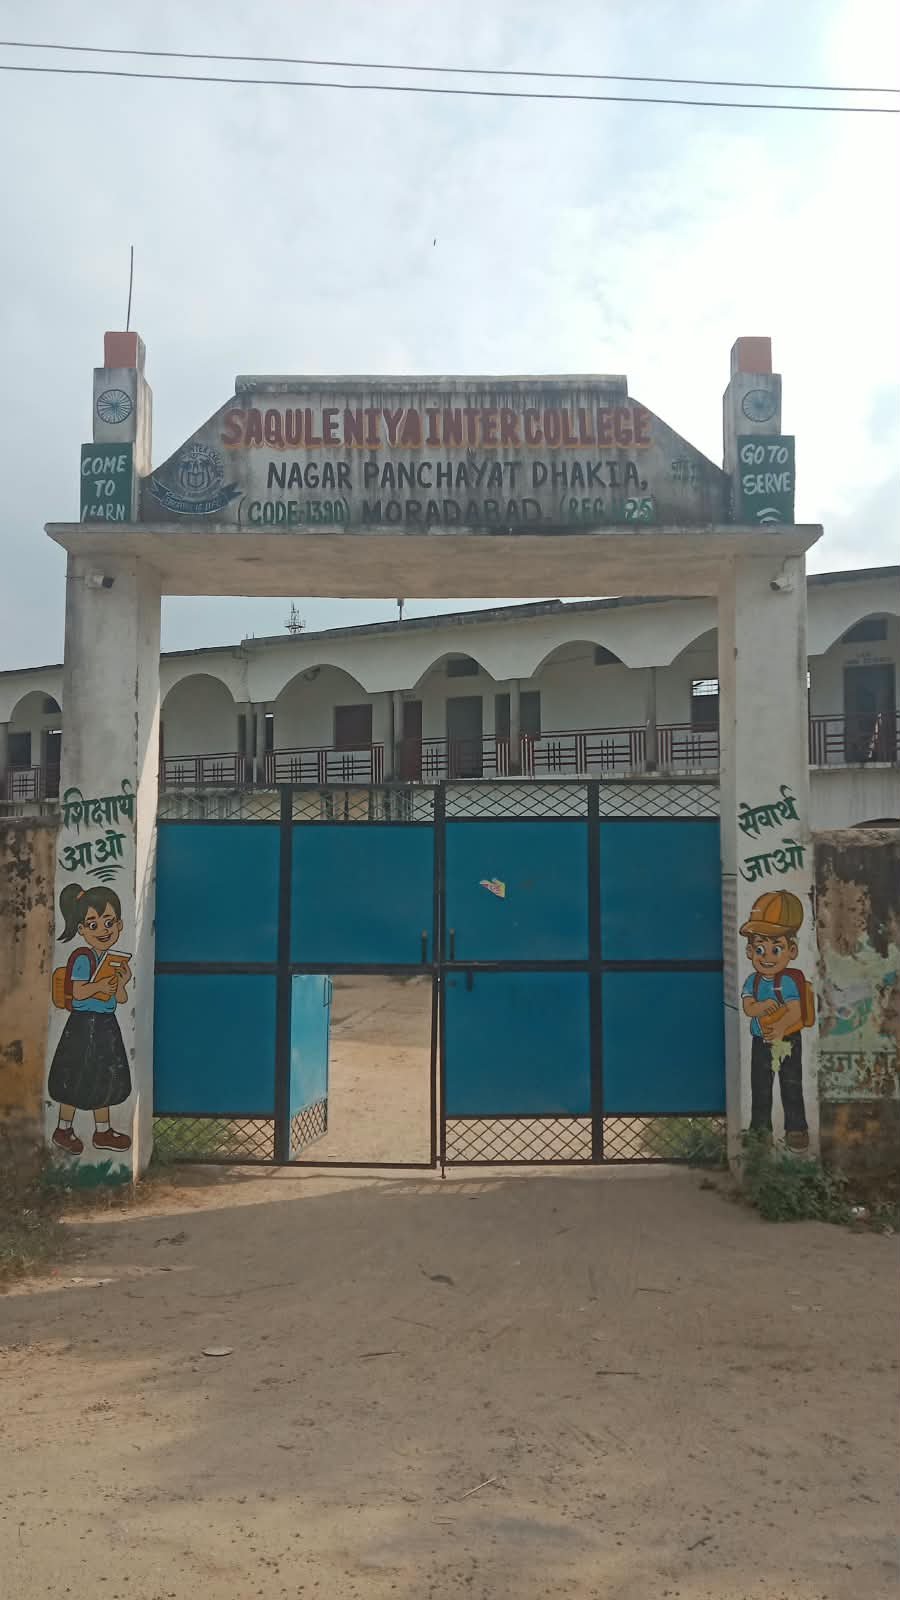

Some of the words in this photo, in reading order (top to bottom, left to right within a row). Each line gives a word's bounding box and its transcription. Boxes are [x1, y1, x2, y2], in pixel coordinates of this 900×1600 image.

[425, 408, 521, 448] INTER
[524, 407, 653, 448] COLLEGE
[82, 455, 128, 476] COME
[741, 443, 765, 465] GO
[767, 445, 789, 464] TO
[93, 479, 116, 497] TO
[266, 461, 353, 489] NAGAR
[363, 460, 522, 489] PANCHAYAT
[531, 460, 649, 490] DHAKIA,
[743, 471, 792, 495] SERVE
[738, 784, 801, 840] सेवार्थ
[59, 829, 127, 872] आओ
[739, 838, 807, 882] जाओ
